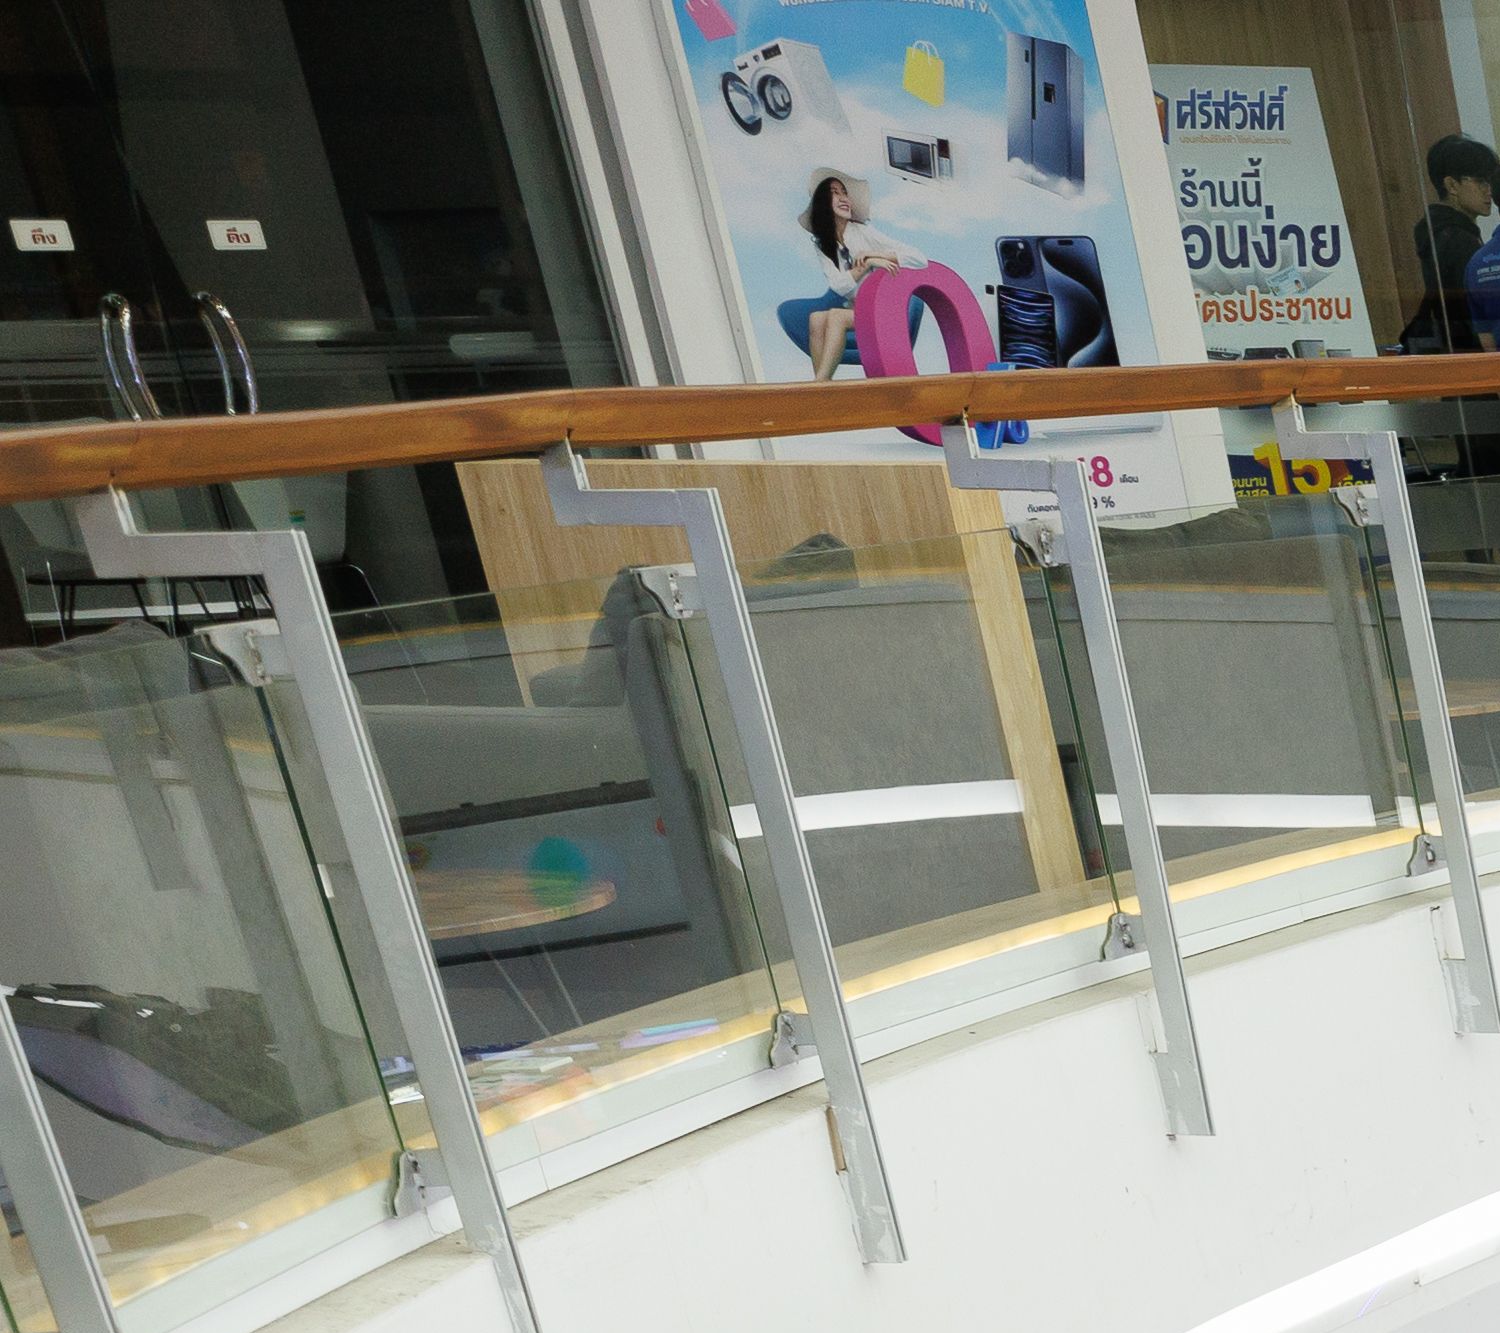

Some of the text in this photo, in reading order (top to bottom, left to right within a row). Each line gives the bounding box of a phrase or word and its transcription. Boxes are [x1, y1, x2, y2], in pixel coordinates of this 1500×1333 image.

[1180, 158, 1262, 208] ร้านนี้
[31, 227, 58, 244] ดึง
[227, 227, 252, 245] ดึง
[1181, 205, 1341, 269] อนง่าย
[1195, 289, 1352, 323] ตรประชาชน
